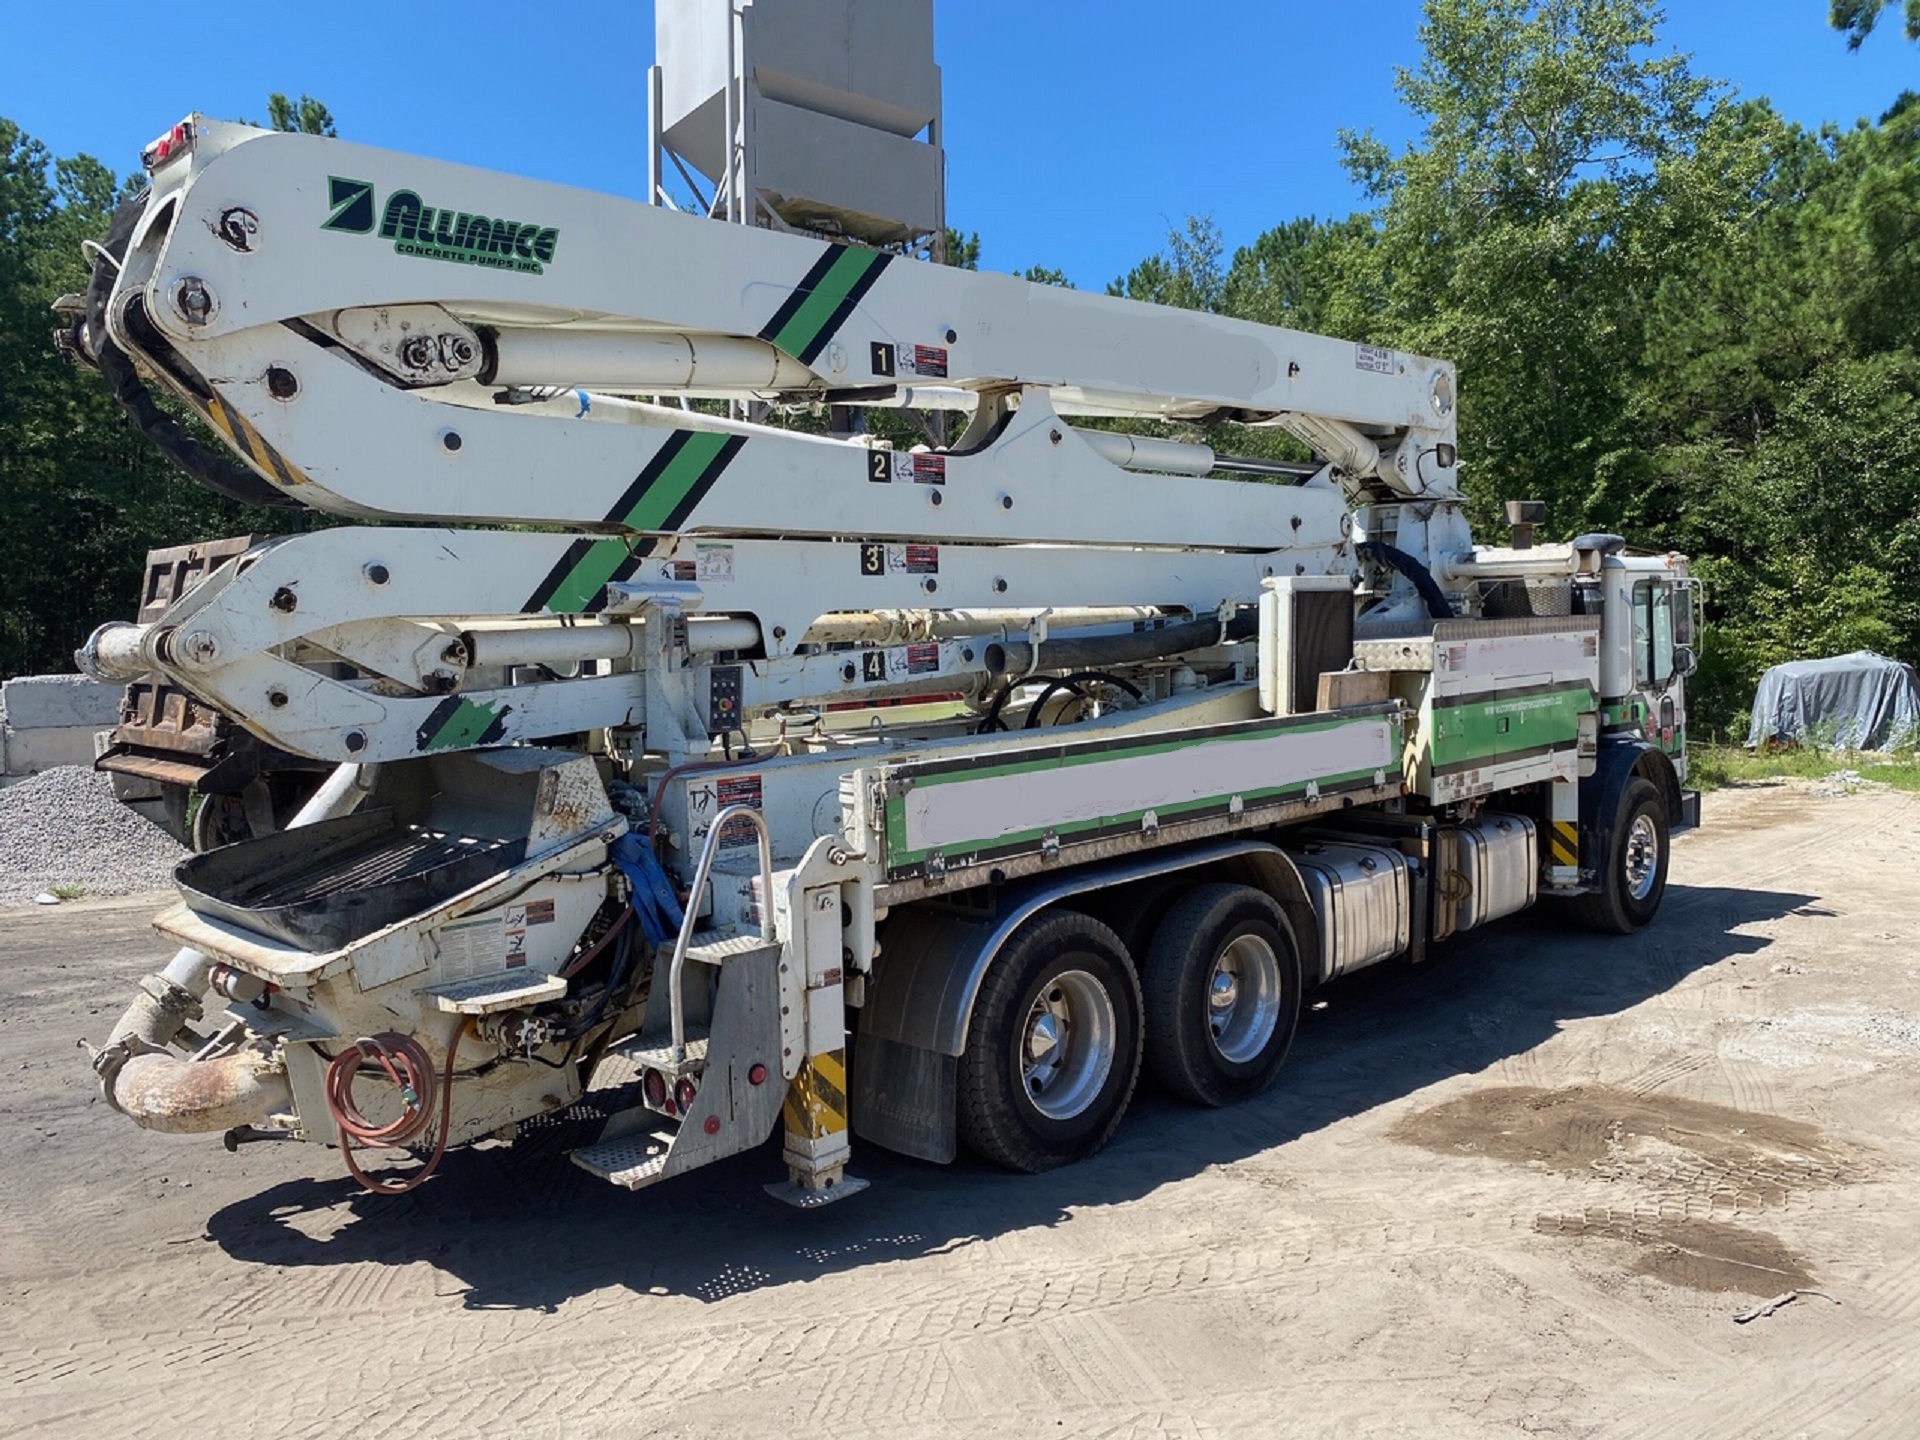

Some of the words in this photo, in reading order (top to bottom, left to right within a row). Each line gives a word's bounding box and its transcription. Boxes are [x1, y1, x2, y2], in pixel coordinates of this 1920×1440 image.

[378, 189, 559, 264] ALLIANCE
[397, 244, 465, 261] CONCRETE
[469, 254, 513, 269] PUMPS
[517, 262, 541, 273] INC.
[877, 347, 887, 372] 1
[874, 454, 886, 478] 2
[866, 546, 879, 571] 3
[869, 653, 880, 677] 4
